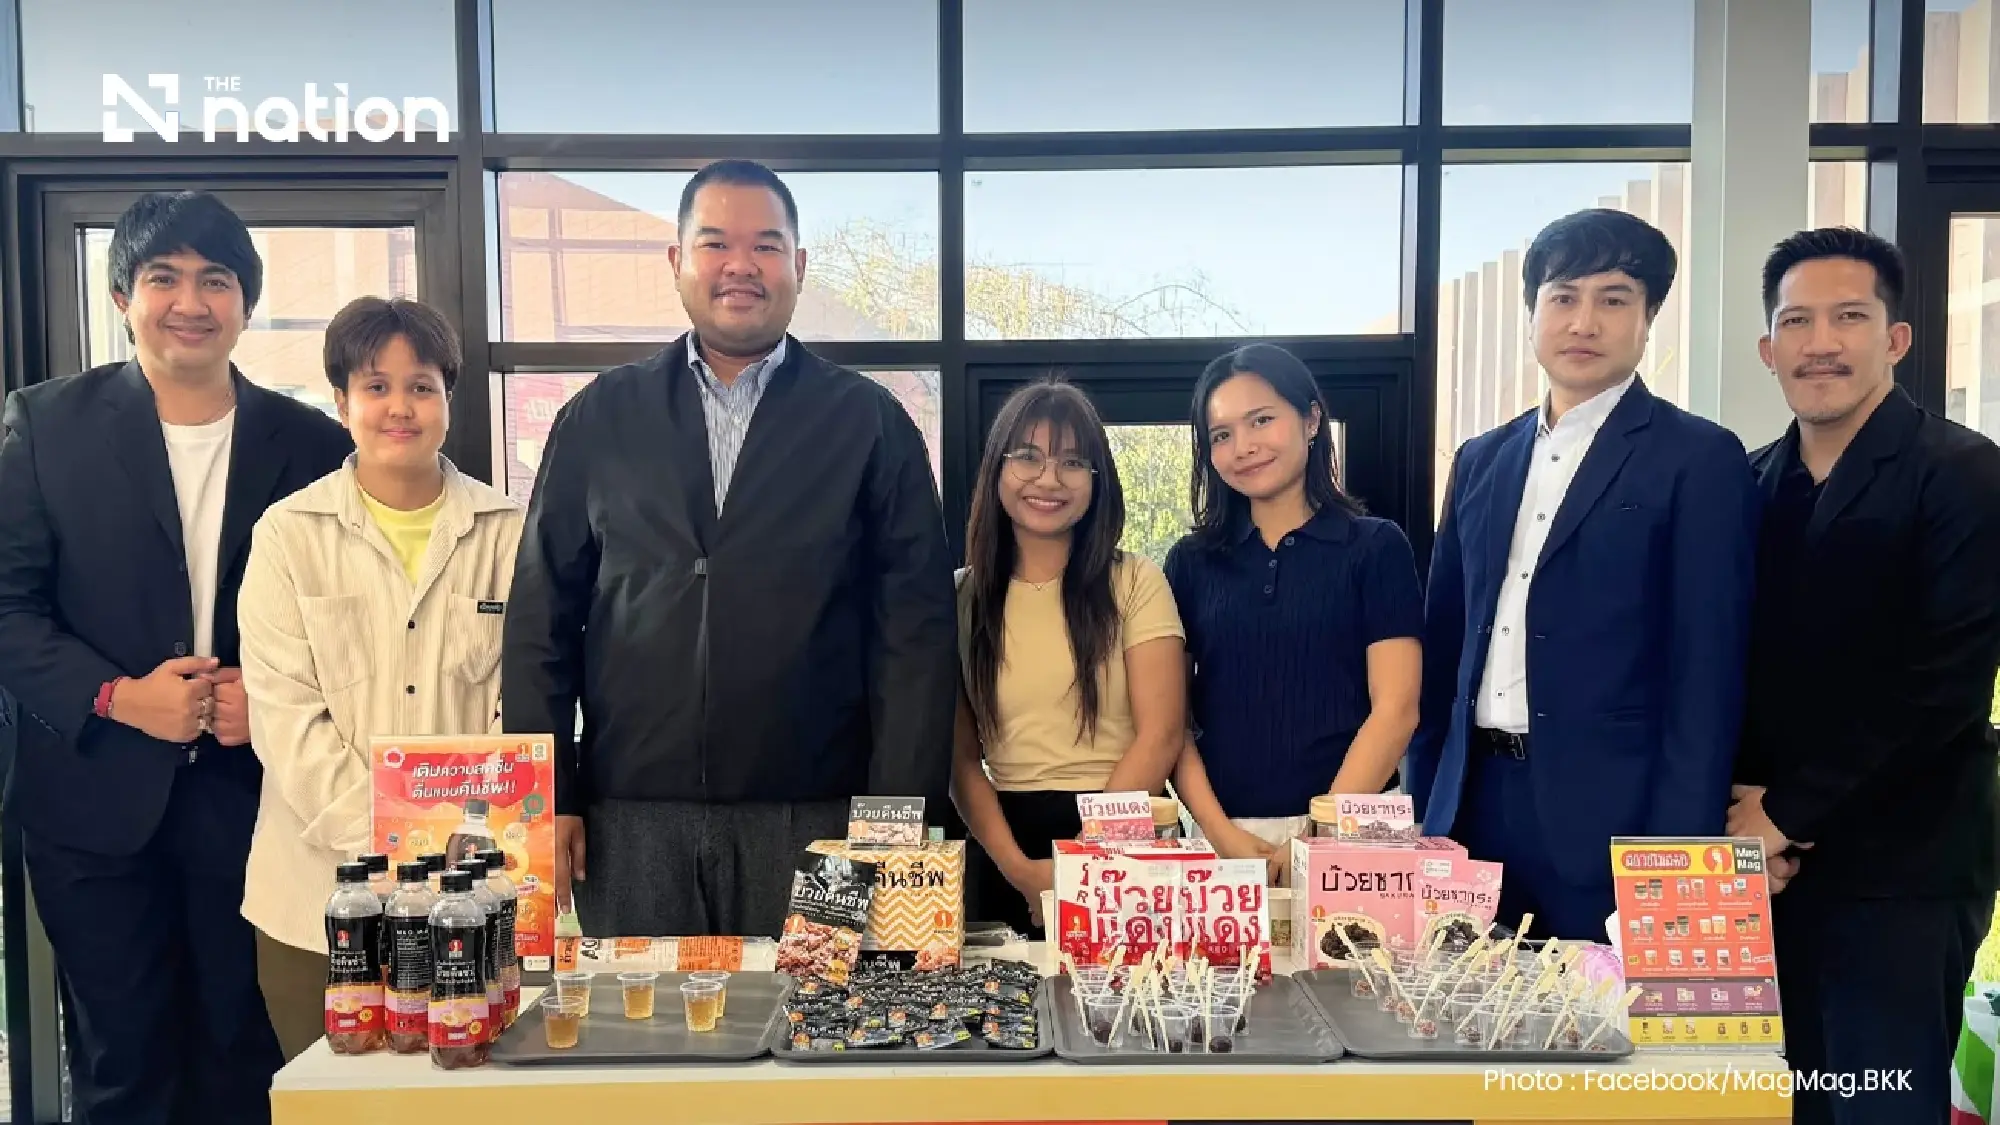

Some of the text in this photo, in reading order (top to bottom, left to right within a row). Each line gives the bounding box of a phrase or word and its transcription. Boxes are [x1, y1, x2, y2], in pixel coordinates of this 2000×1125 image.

[1079, 797, 1151, 818] บ๊วยแดง
[1734, 847, 1760, 860] Mag
[1737, 859, 1761, 872] Mag
[1094, 869, 1174, 914] บ๊วย
[1180, 869, 1262, 913] บ๊วย
